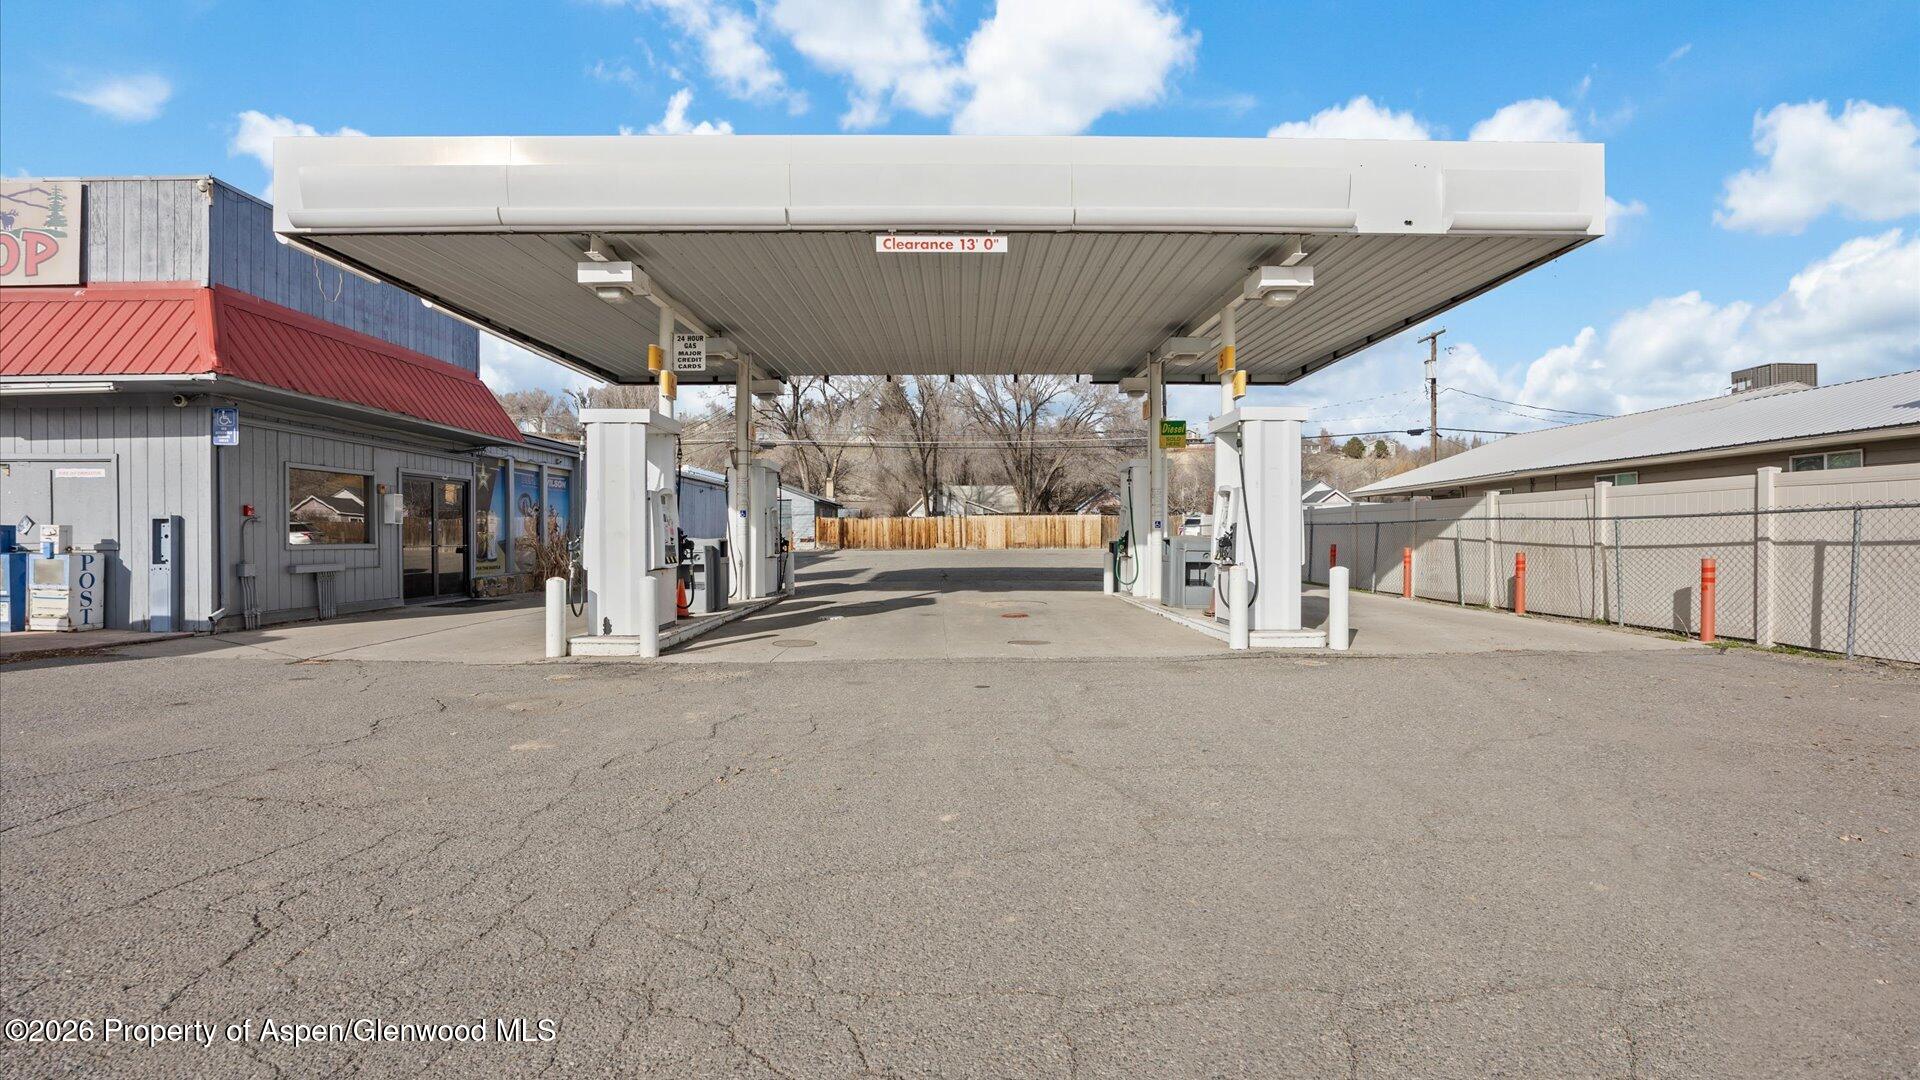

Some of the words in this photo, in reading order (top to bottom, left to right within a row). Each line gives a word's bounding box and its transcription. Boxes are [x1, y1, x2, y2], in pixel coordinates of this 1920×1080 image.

[883, 237, 954, 250] Clearance
[960, 238, 979, 251] 13'
[984, 238, 1000, 251] 0"
[1162, 423, 1186, 434] Diesel
[79, 554, 96, 625] POST
